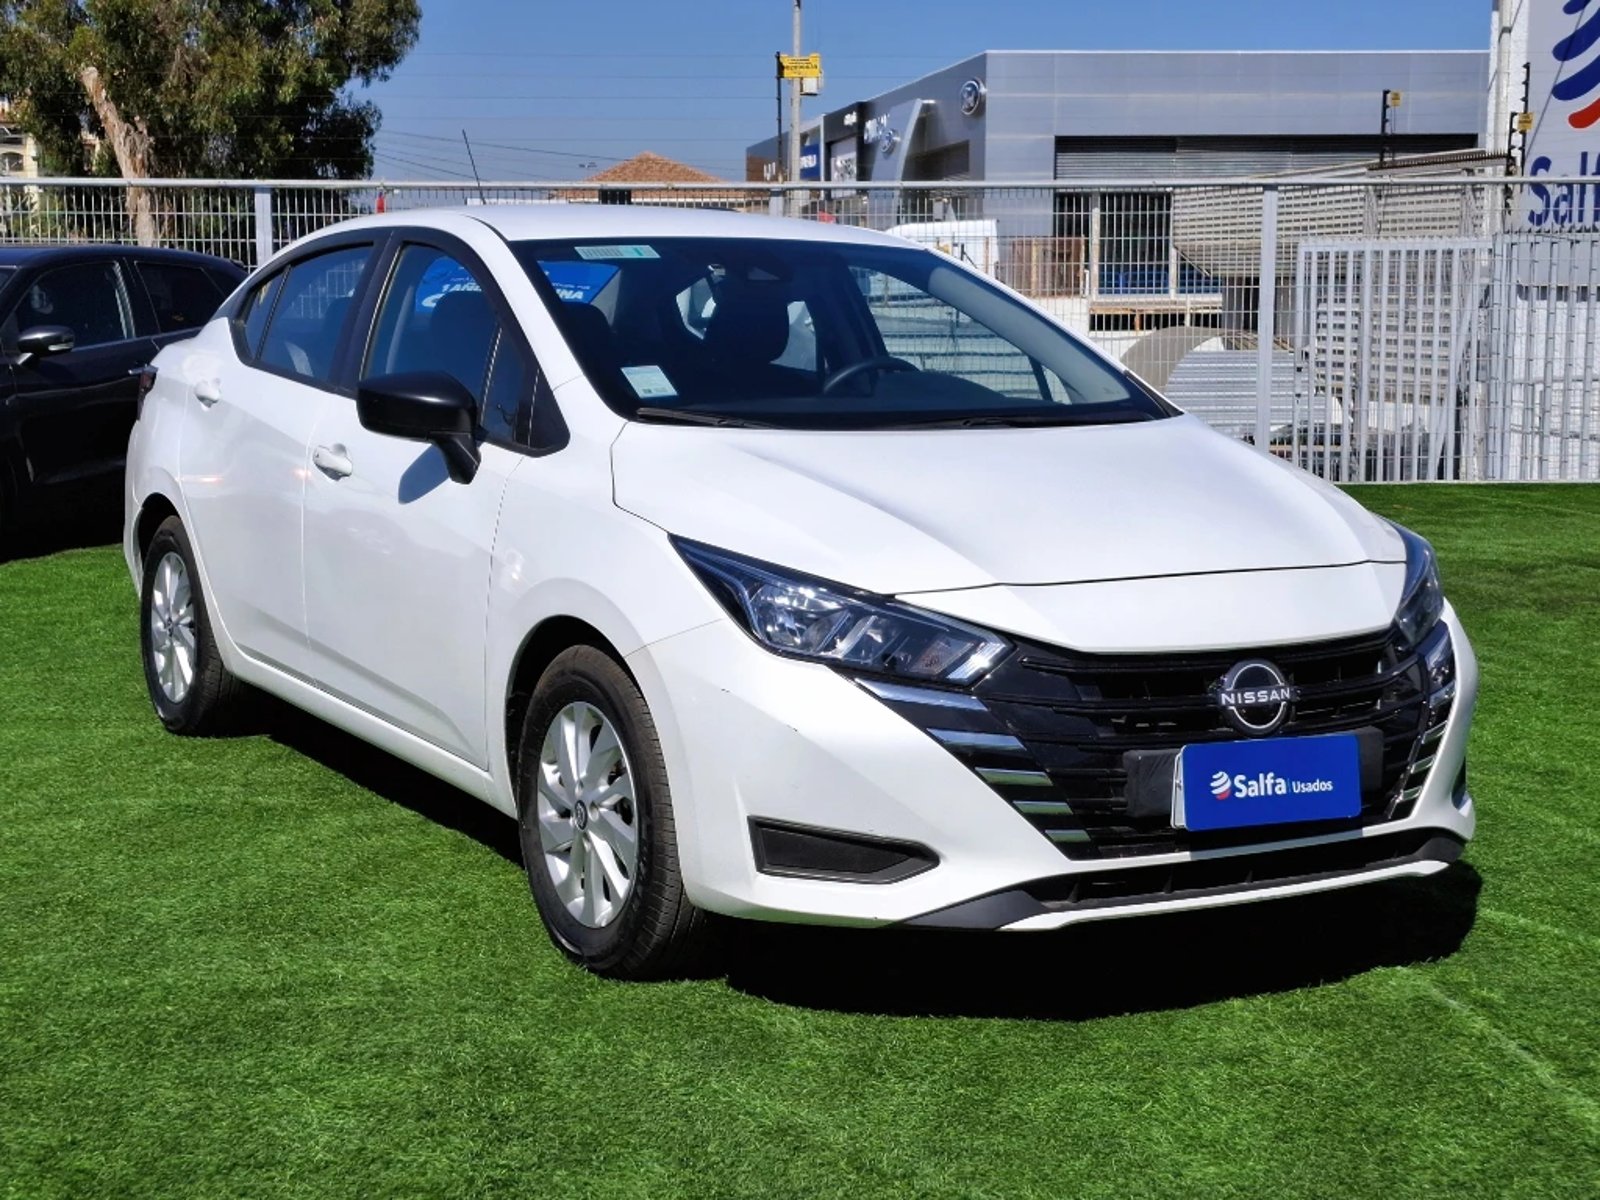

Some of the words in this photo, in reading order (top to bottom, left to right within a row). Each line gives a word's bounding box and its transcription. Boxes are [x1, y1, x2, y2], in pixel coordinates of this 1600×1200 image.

[1221, 688, 1290, 704] NISSAN
[1234, 772, 1287, 797] Salfa
[1292, 779, 1333, 793] Usados
